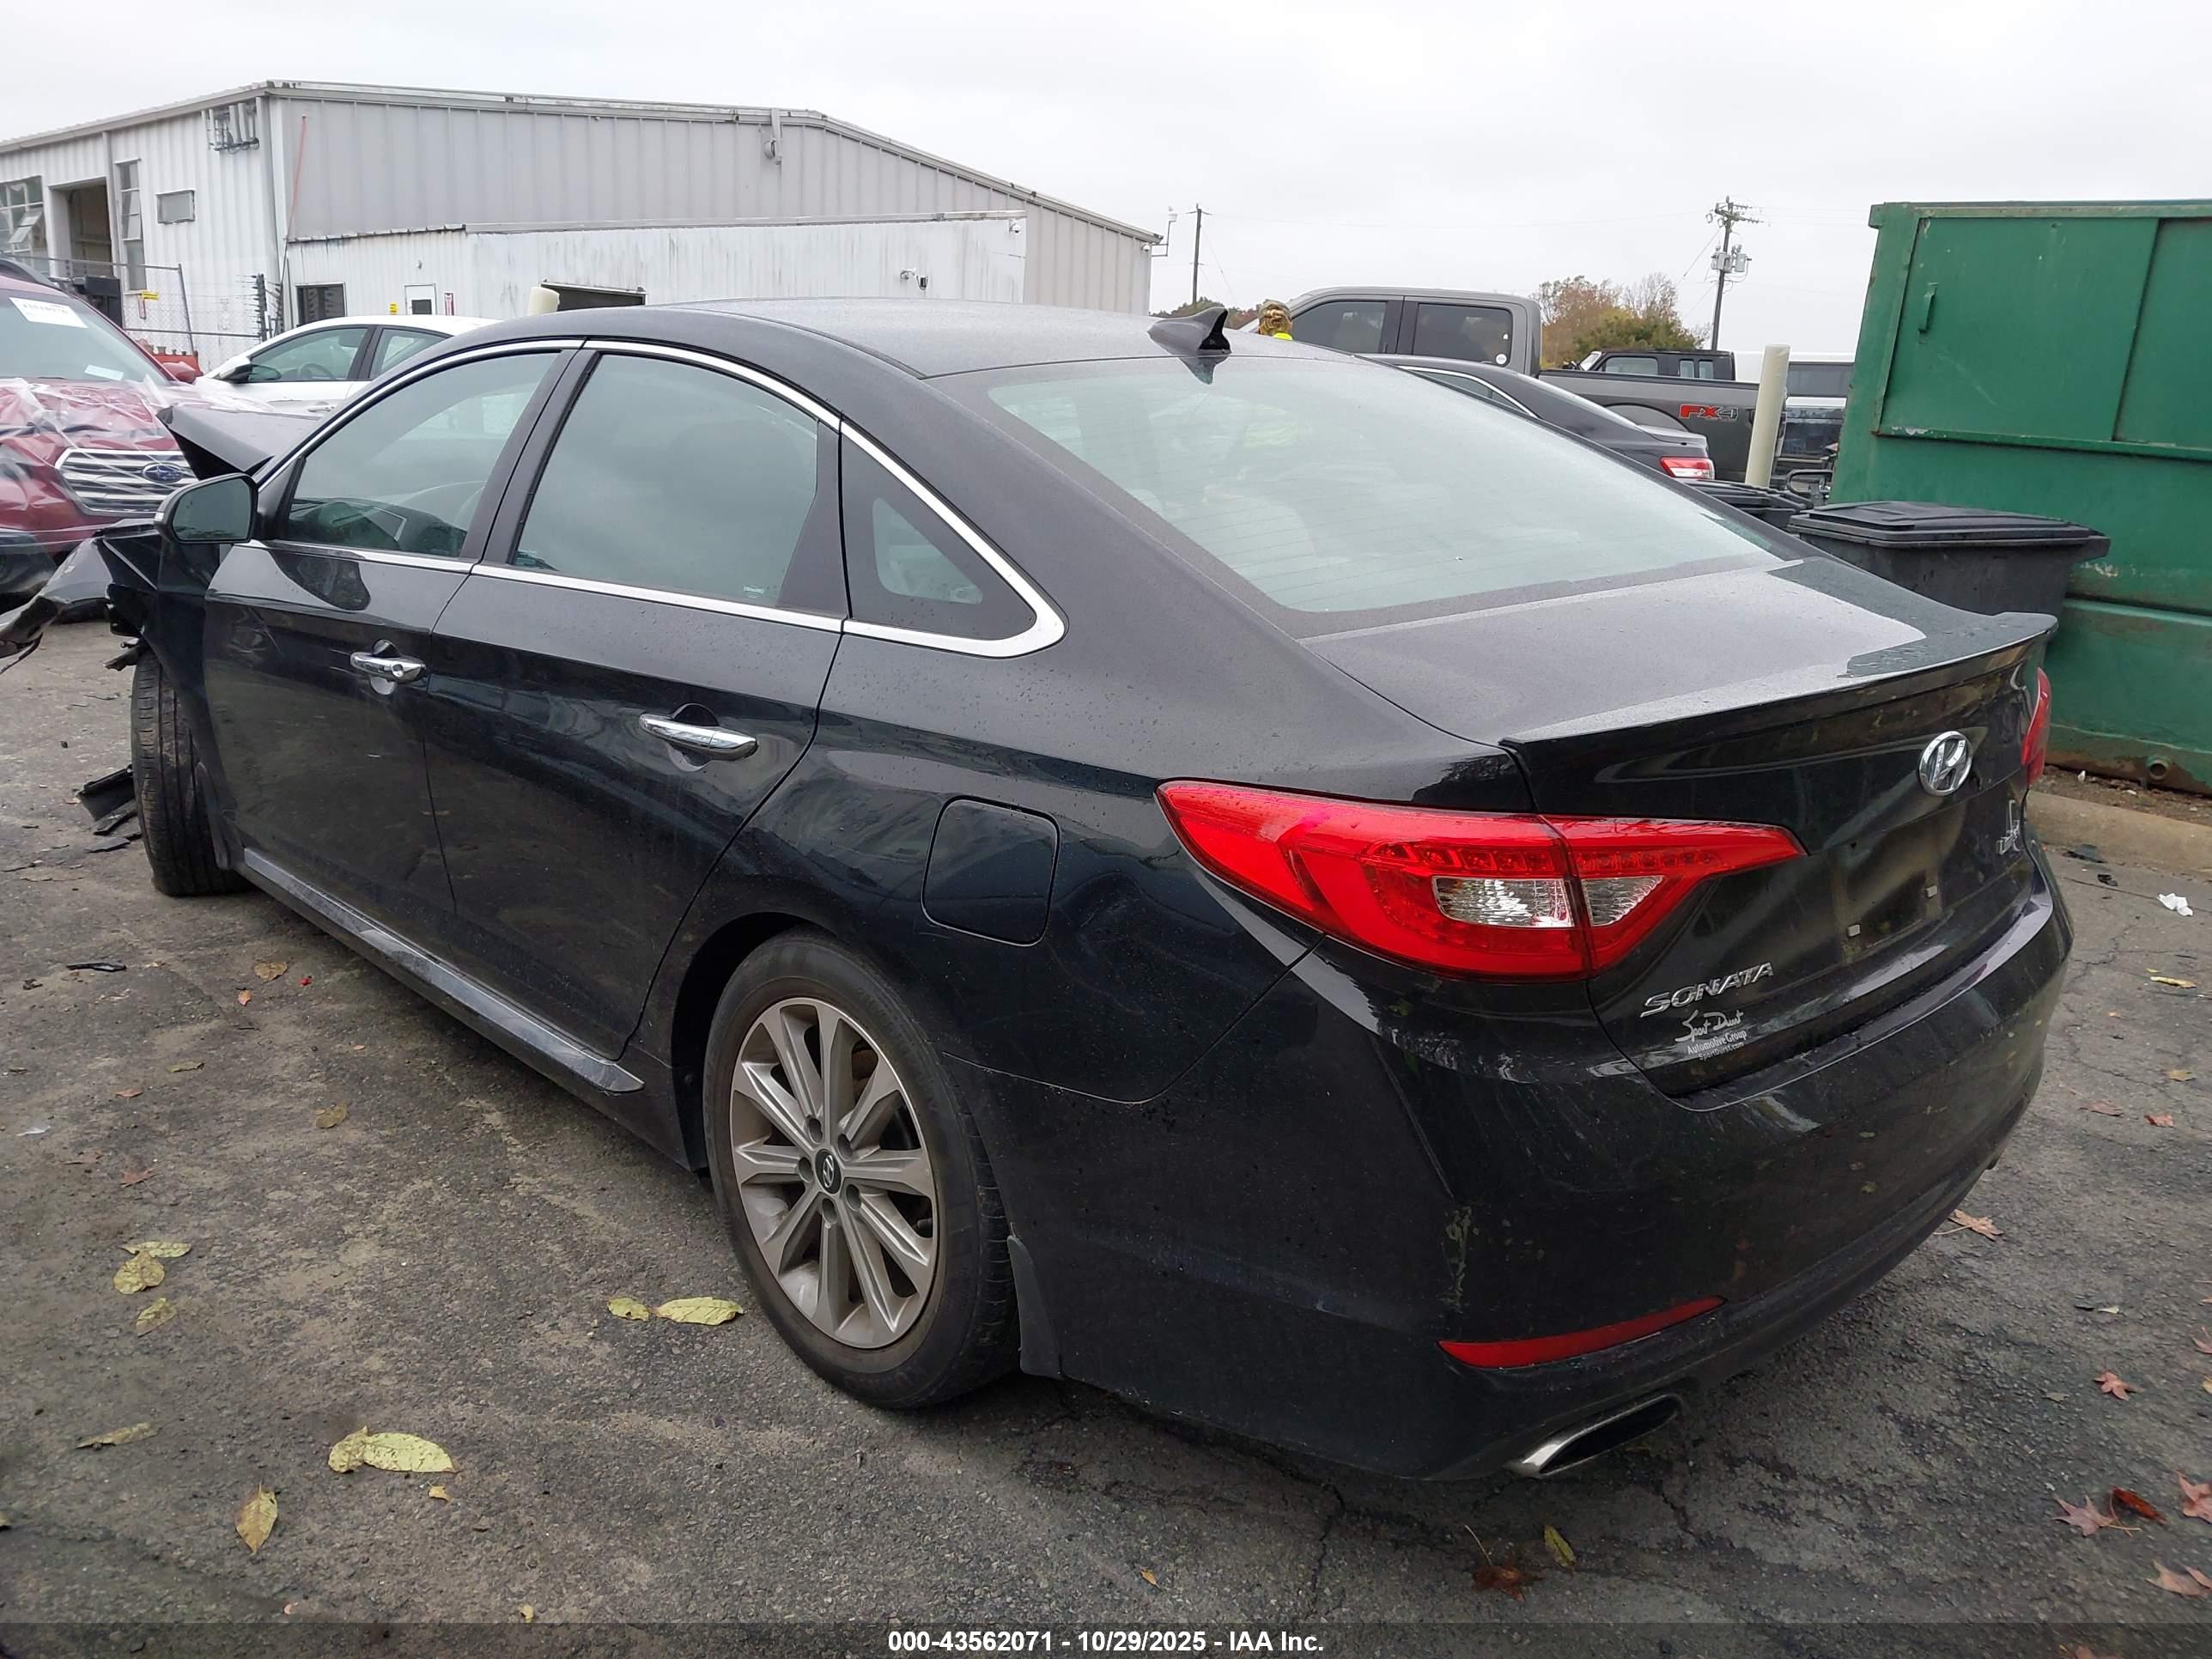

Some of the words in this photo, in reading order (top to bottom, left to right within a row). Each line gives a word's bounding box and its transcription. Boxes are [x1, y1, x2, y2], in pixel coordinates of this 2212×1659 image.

[1680, 404, 1738, 420] FX4
[1639, 962, 1774, 1018] SONATA
[1674, 1009, 1711, 1042] Sport
[1686, 1036, 1728, 1055] Automotive
[1724, 1030, 1747, 1042] Group
